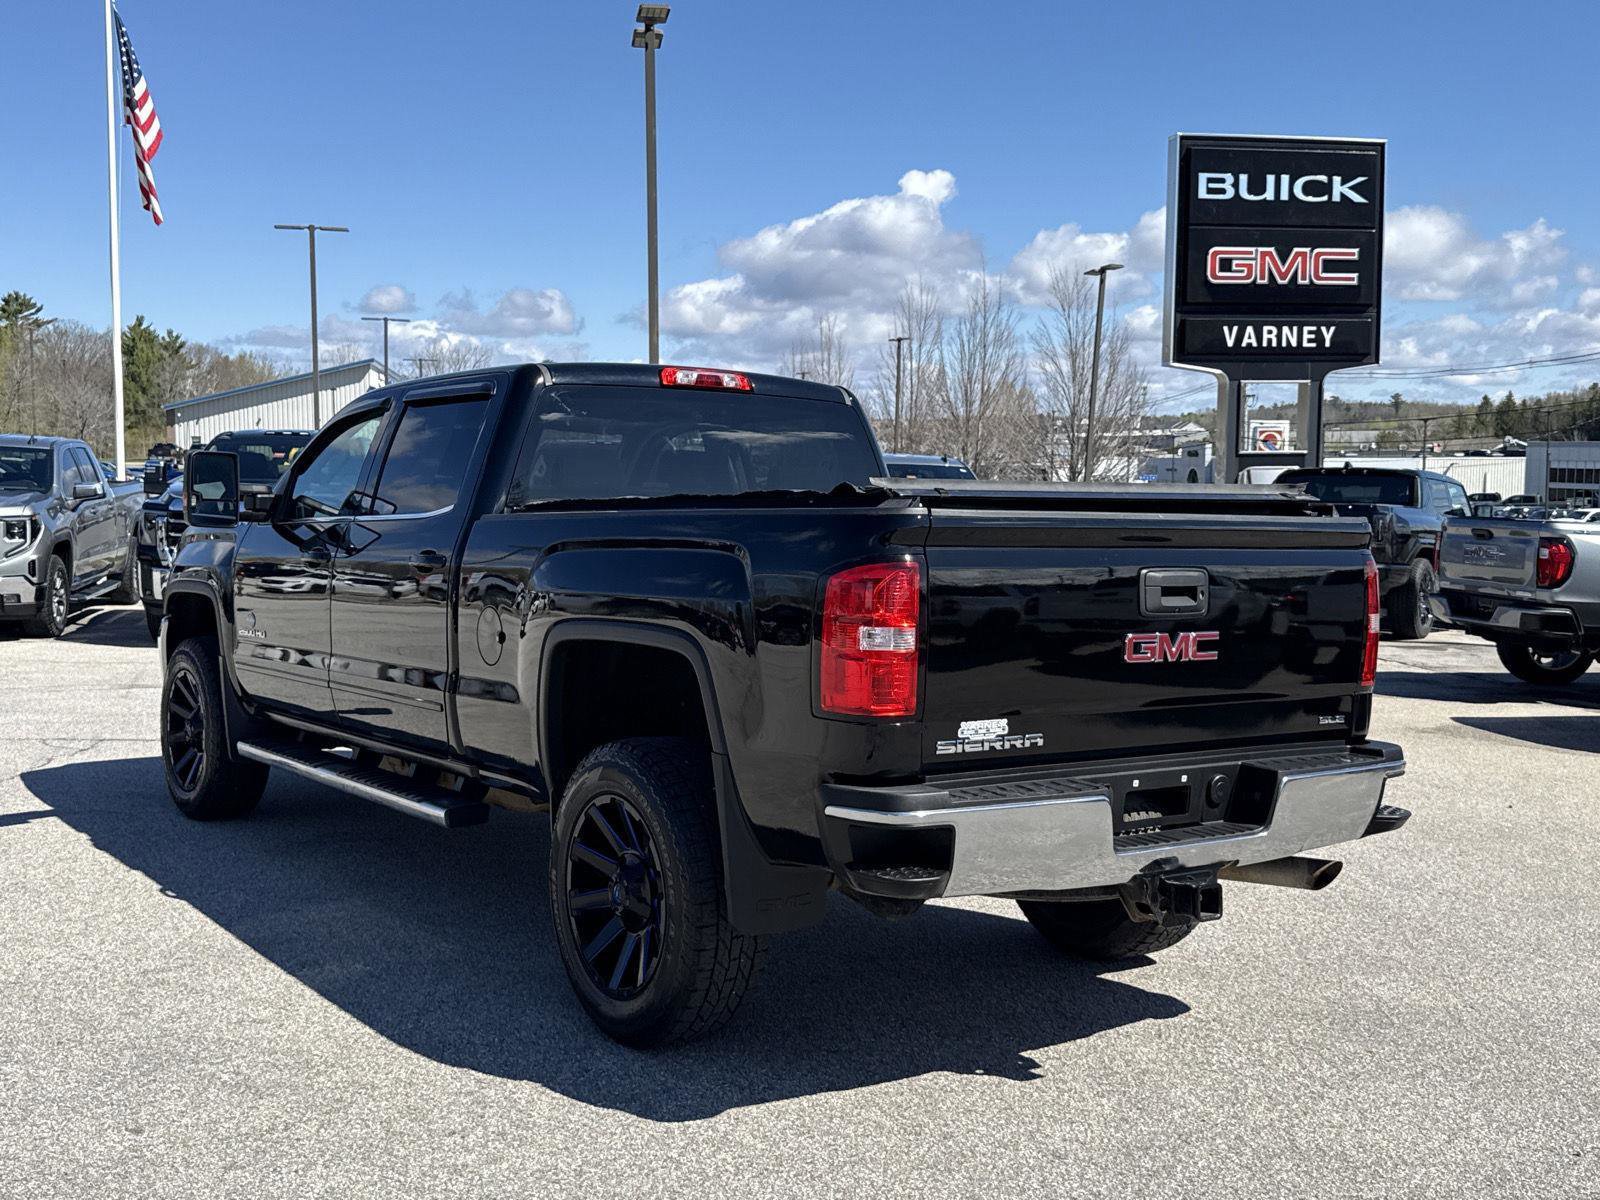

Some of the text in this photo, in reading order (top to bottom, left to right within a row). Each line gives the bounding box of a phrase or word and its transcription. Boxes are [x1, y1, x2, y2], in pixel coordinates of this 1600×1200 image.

[1197, 172, 1369, 203] BUICK
[1207, 246, 1360, 285] GMC
[1223, 325, 1336, 348] VARNEY
[1124, 631, 1220, 663] GMC
[936, 733, 1044, 755] SIERRA
